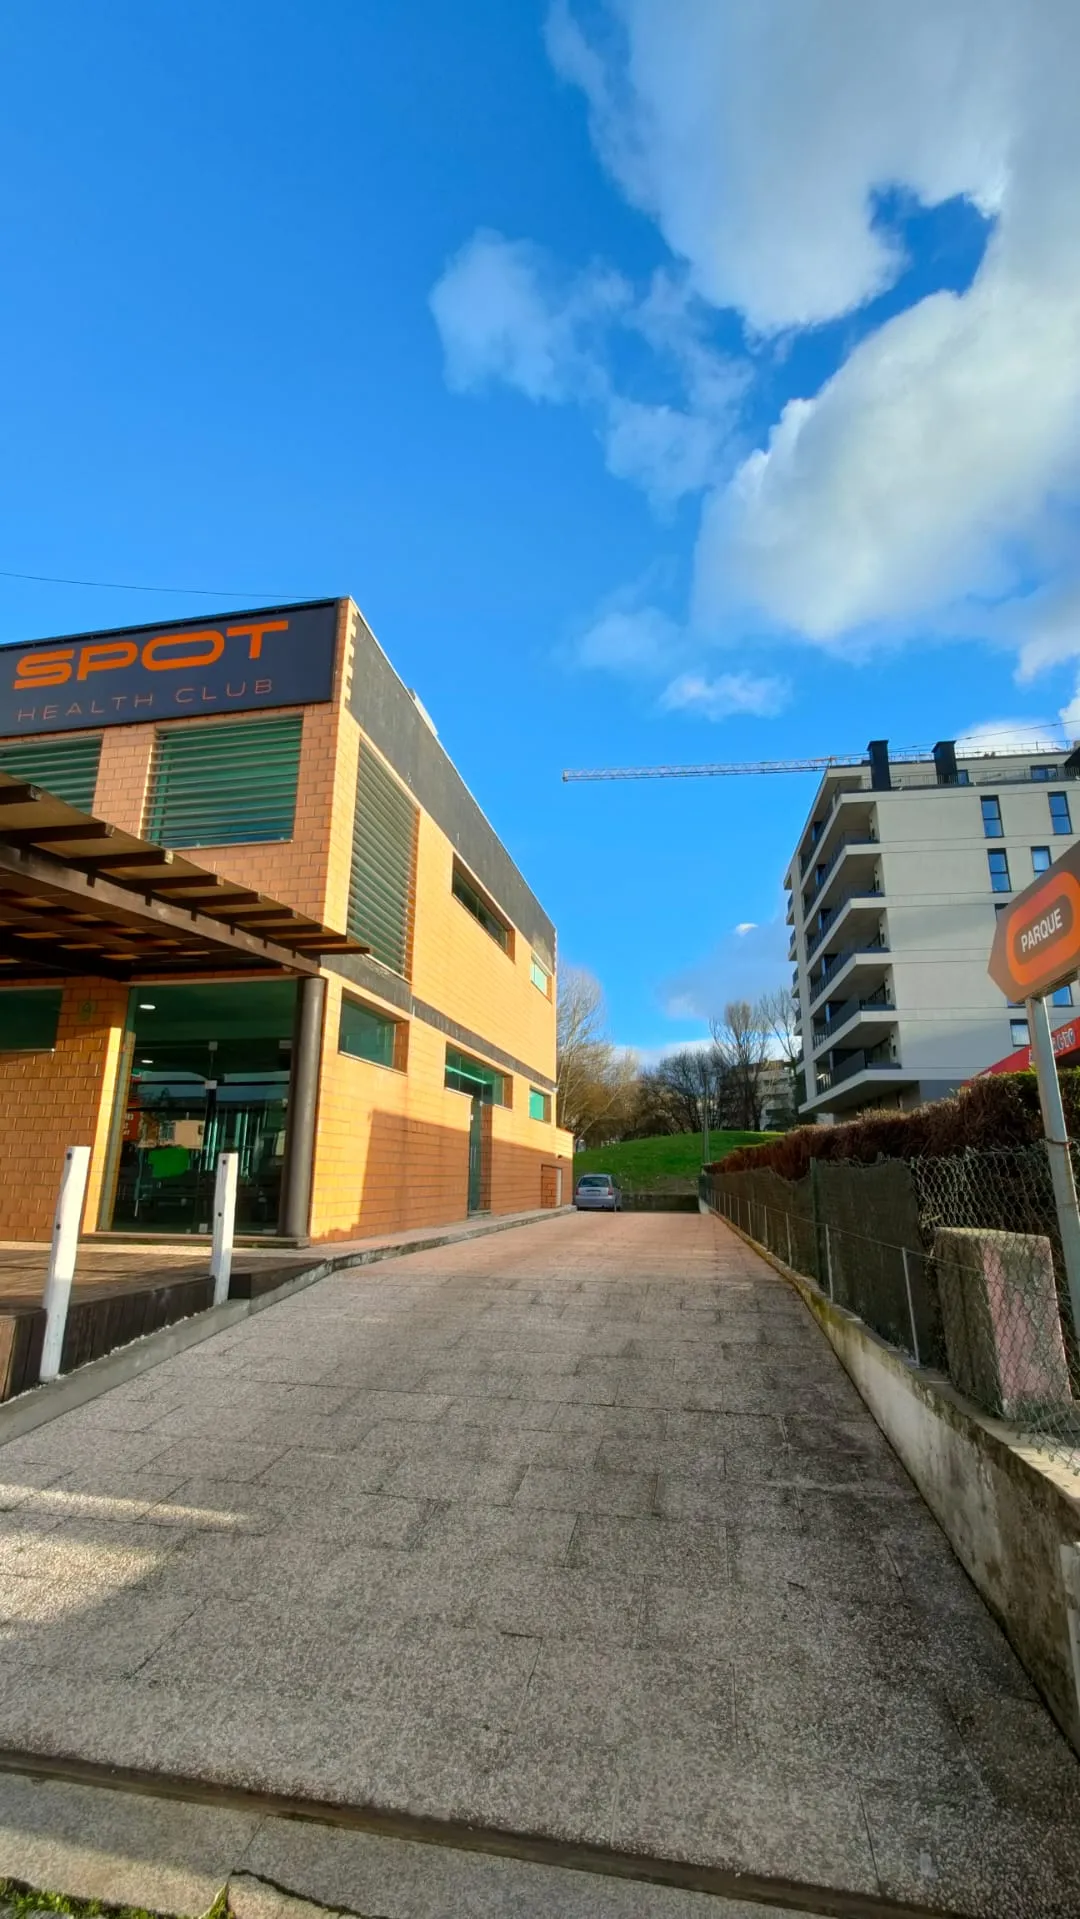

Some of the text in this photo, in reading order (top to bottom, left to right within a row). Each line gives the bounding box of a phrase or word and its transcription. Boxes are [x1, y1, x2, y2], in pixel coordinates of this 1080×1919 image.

[13, 621, 289, 690] SPOT
[18, 679, 273, 722] HEALTH CLUB
[1021, 908, 1063, 953] PARQUE
